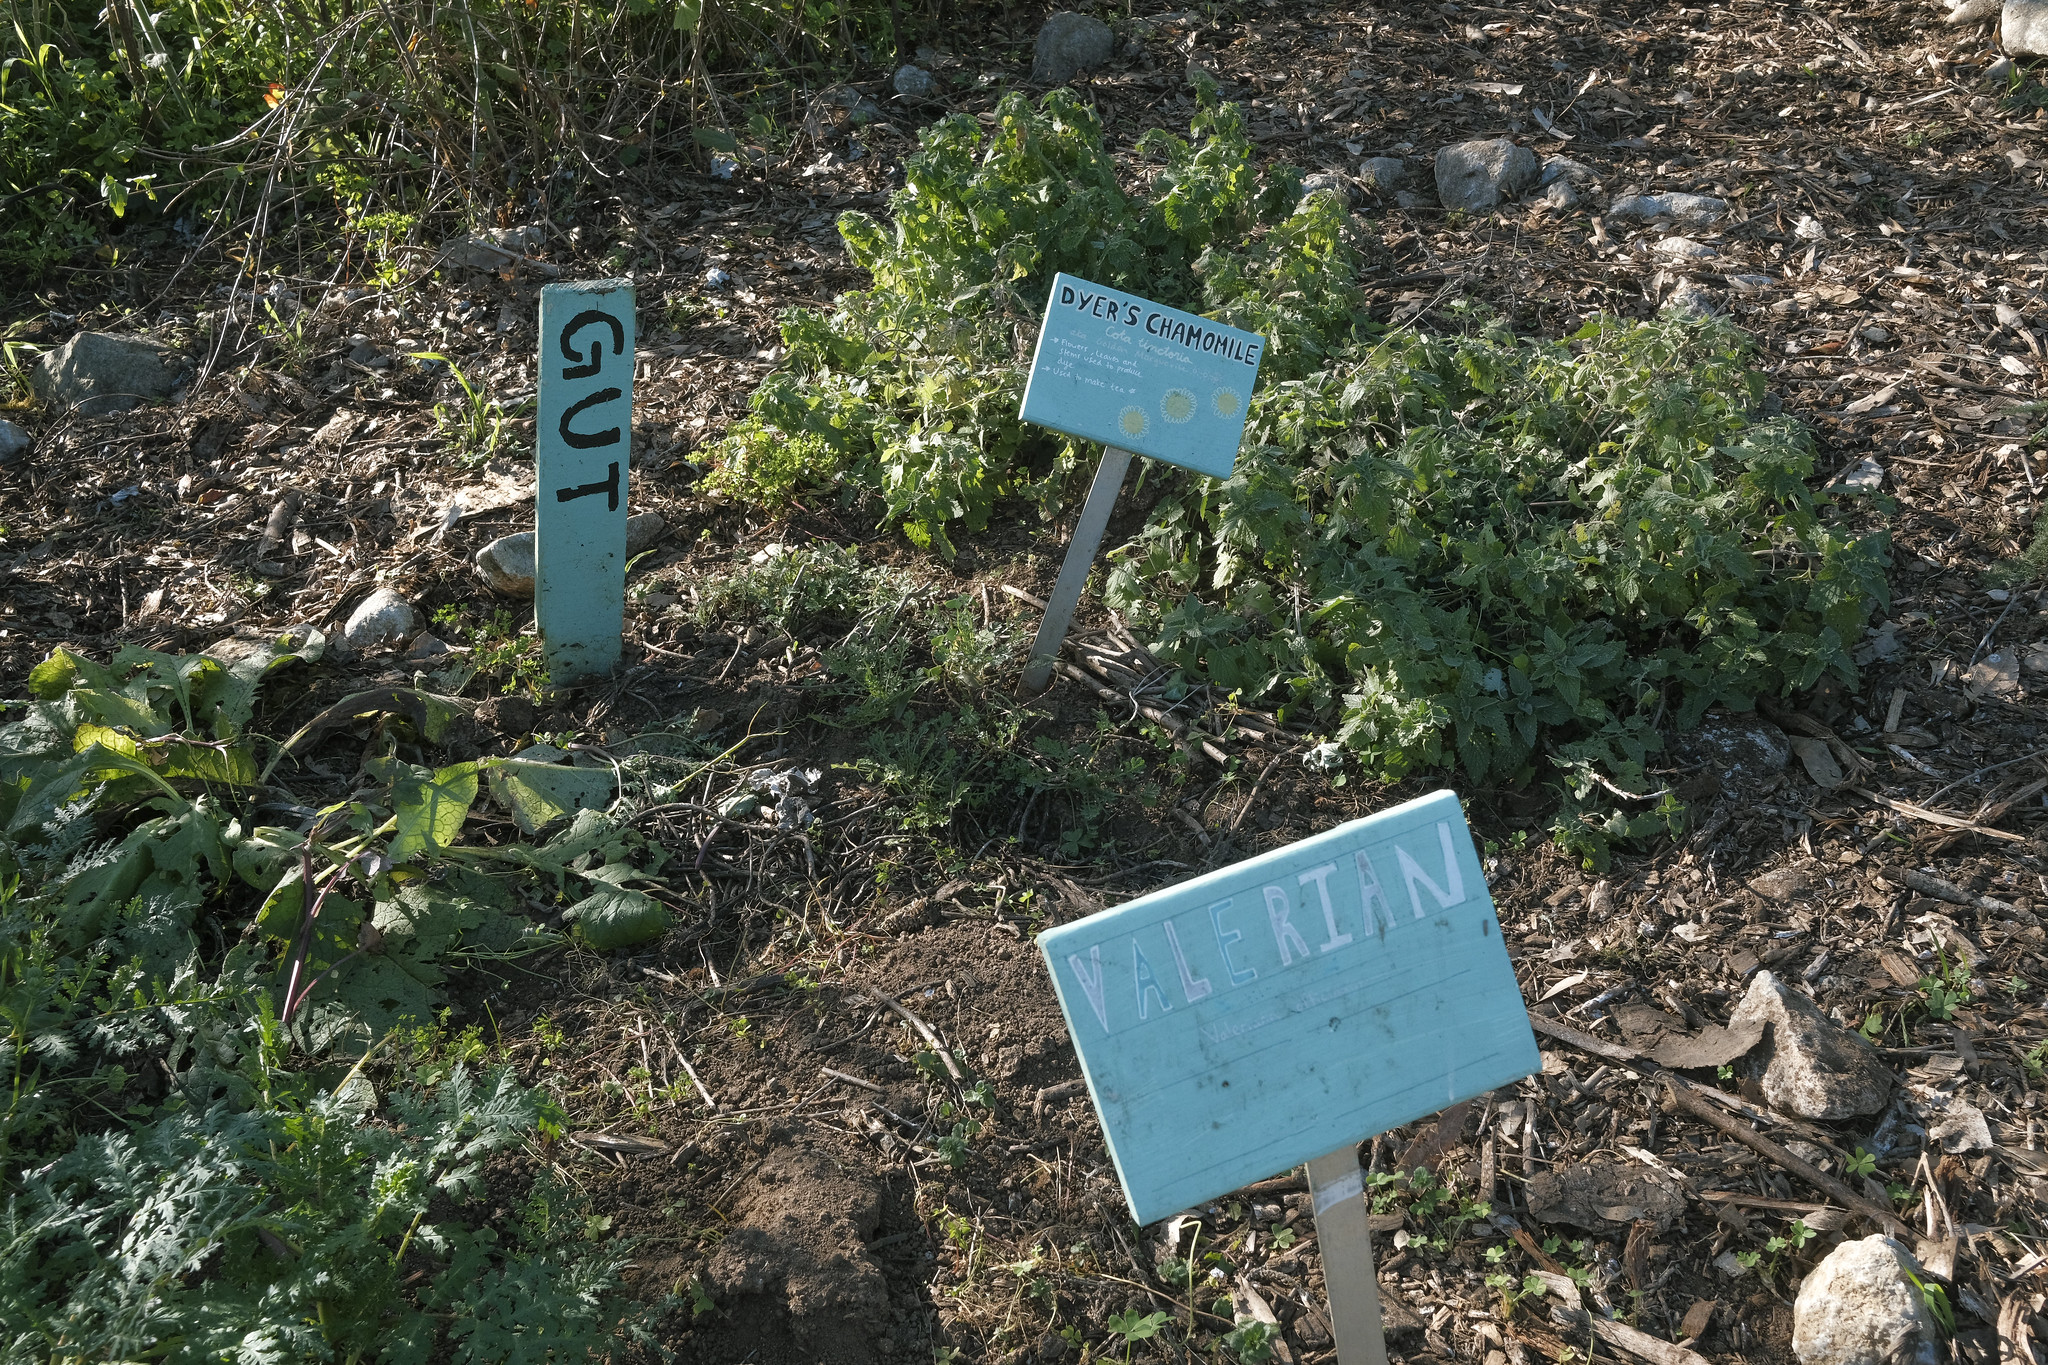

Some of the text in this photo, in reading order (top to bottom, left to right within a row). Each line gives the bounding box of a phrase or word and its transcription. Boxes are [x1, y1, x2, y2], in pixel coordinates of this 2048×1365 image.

[1061, 286, 1259, 366] DYER'S CHAMOMILE
[1105, 326, 1194, 365] Cota tinctoria
[1057, 356, 1075, 370] dye
[1084, 356, 1103, 367] used
[1105, 361, 1114, 370] to
[1116, 366, 1144, 378] produce
[1122, 360, 1139, 368] and
[1053, 367, 1126, 394] Used to make tea
[556, 310, 625, 512] GUT
[1067, 821, 1467, 1035] VALERIAN
